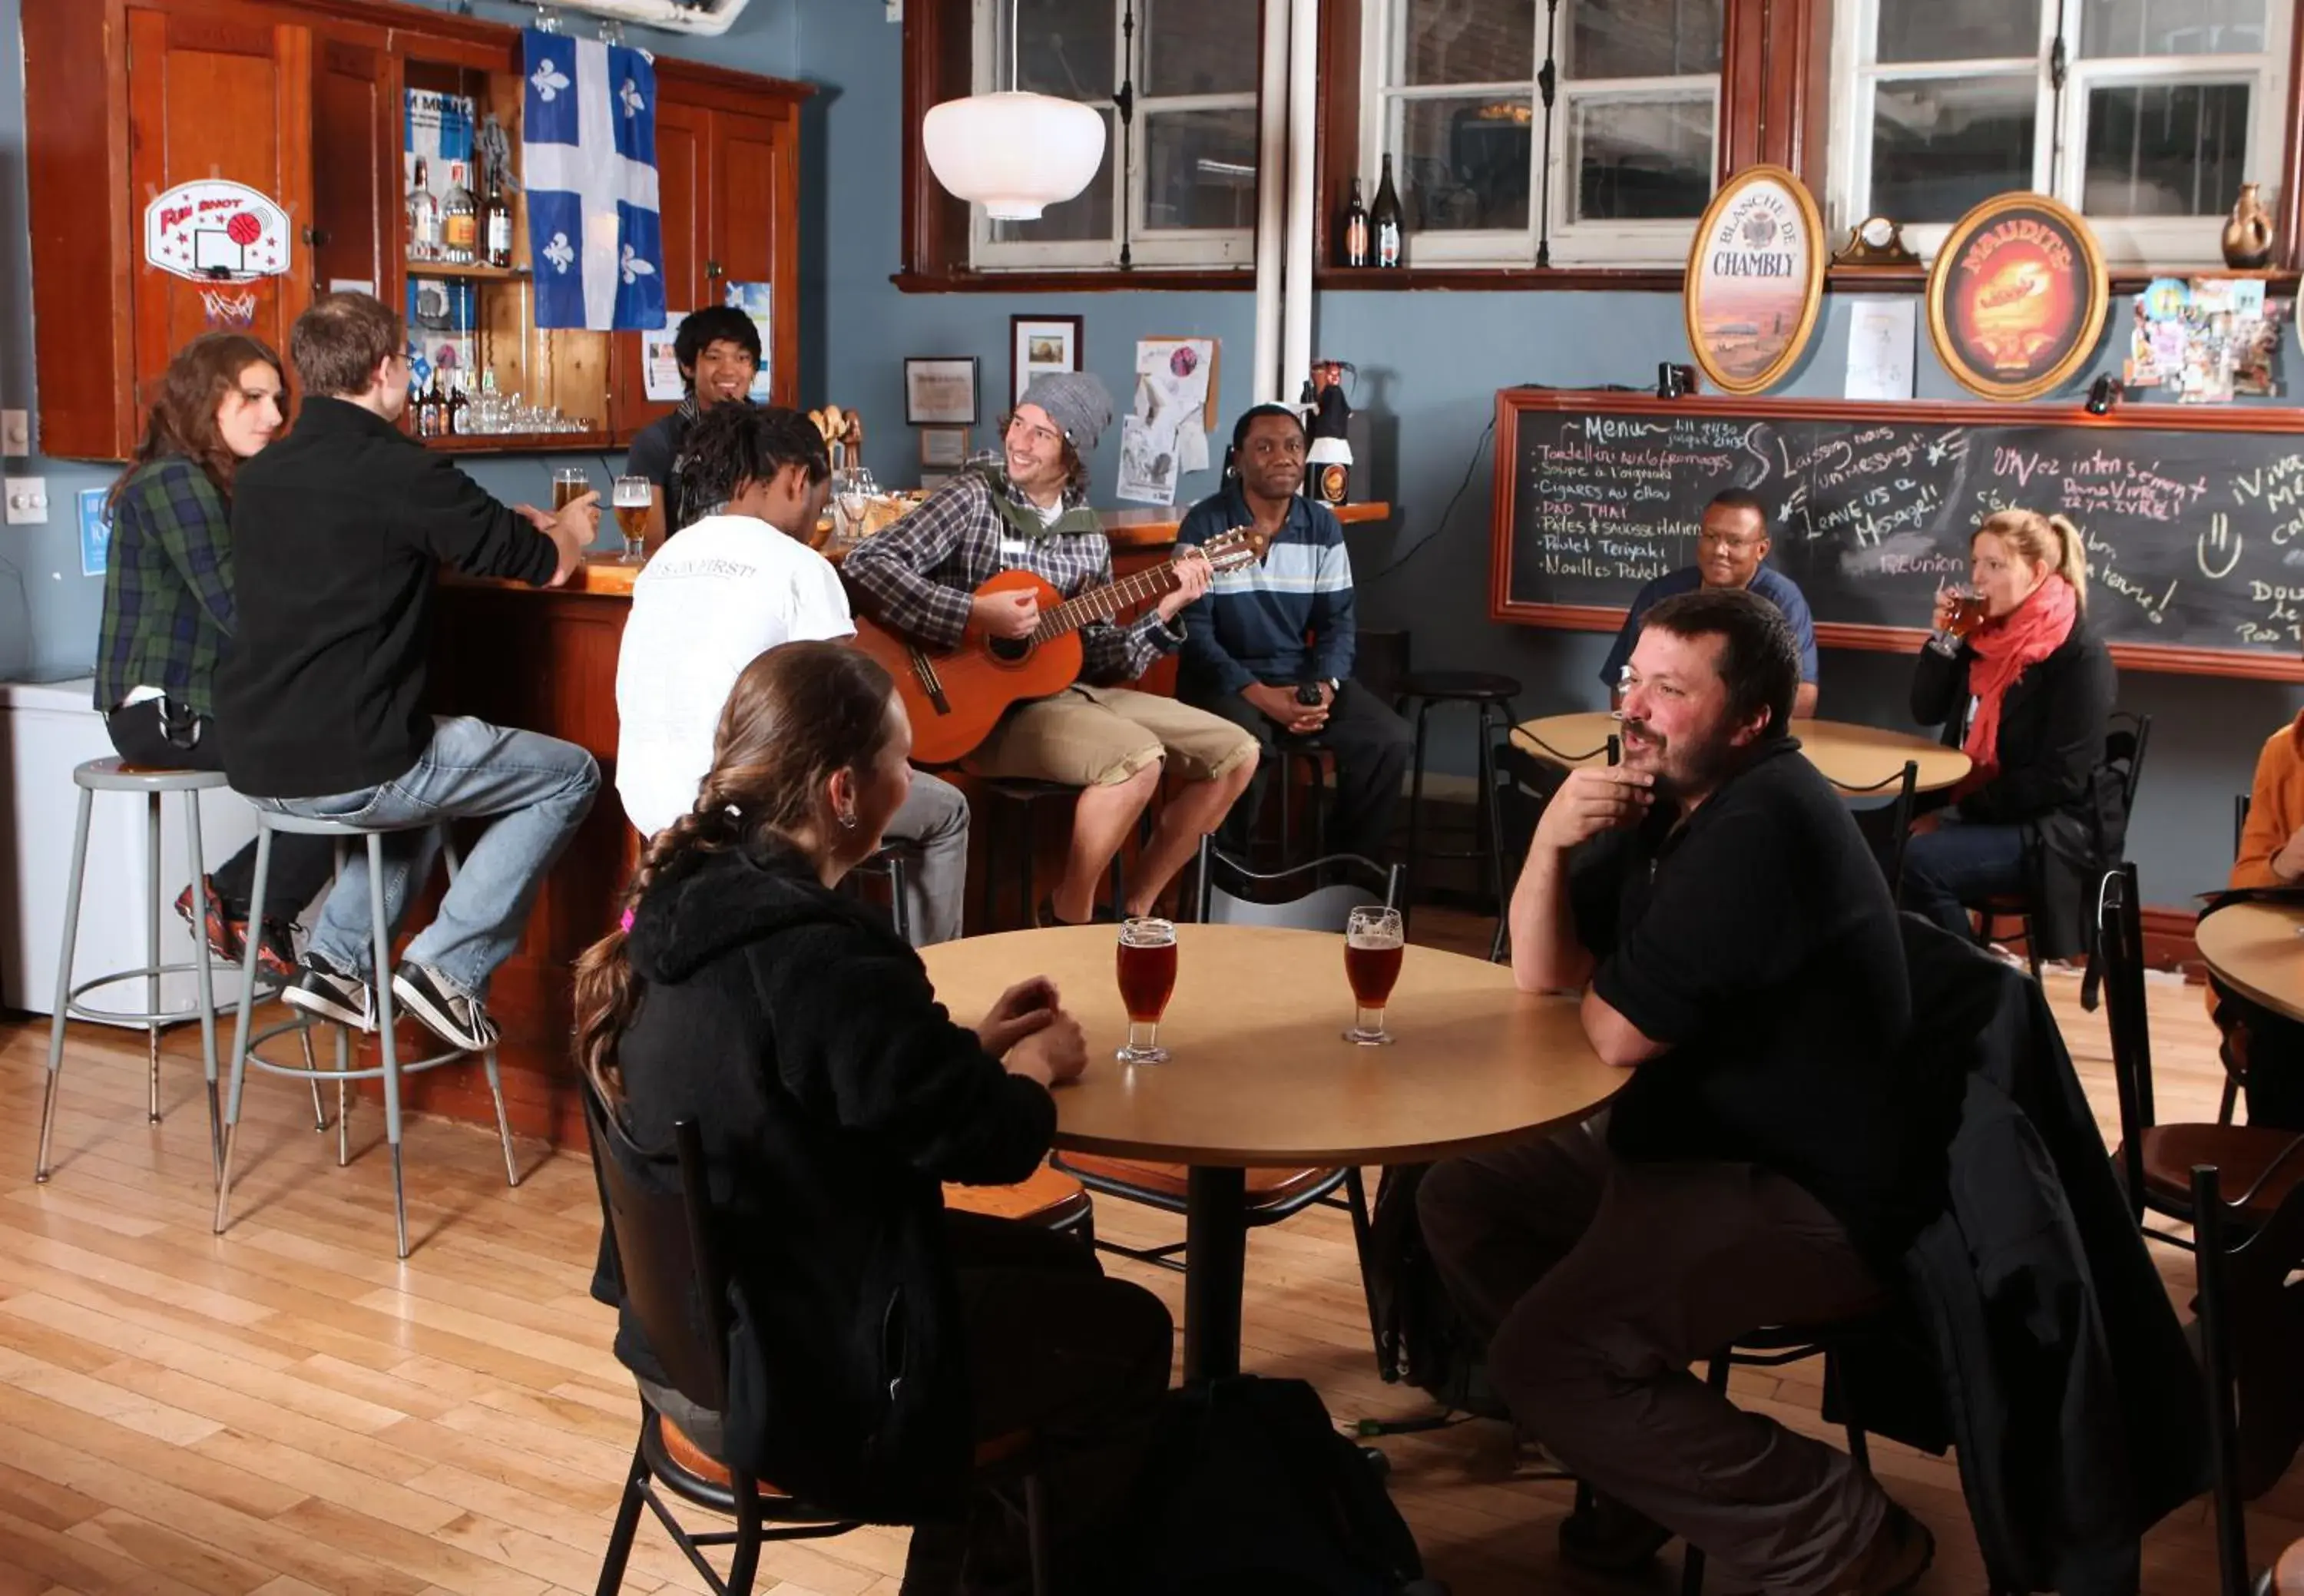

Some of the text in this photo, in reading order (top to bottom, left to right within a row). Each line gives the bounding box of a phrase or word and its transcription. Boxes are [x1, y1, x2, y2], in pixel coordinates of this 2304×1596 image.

[1720, 194, 1796, 245] BLANCHE DE
[1713, 252, 1796, 277] CHAMBLY
[1585, 416, 1646, 444] Menu
